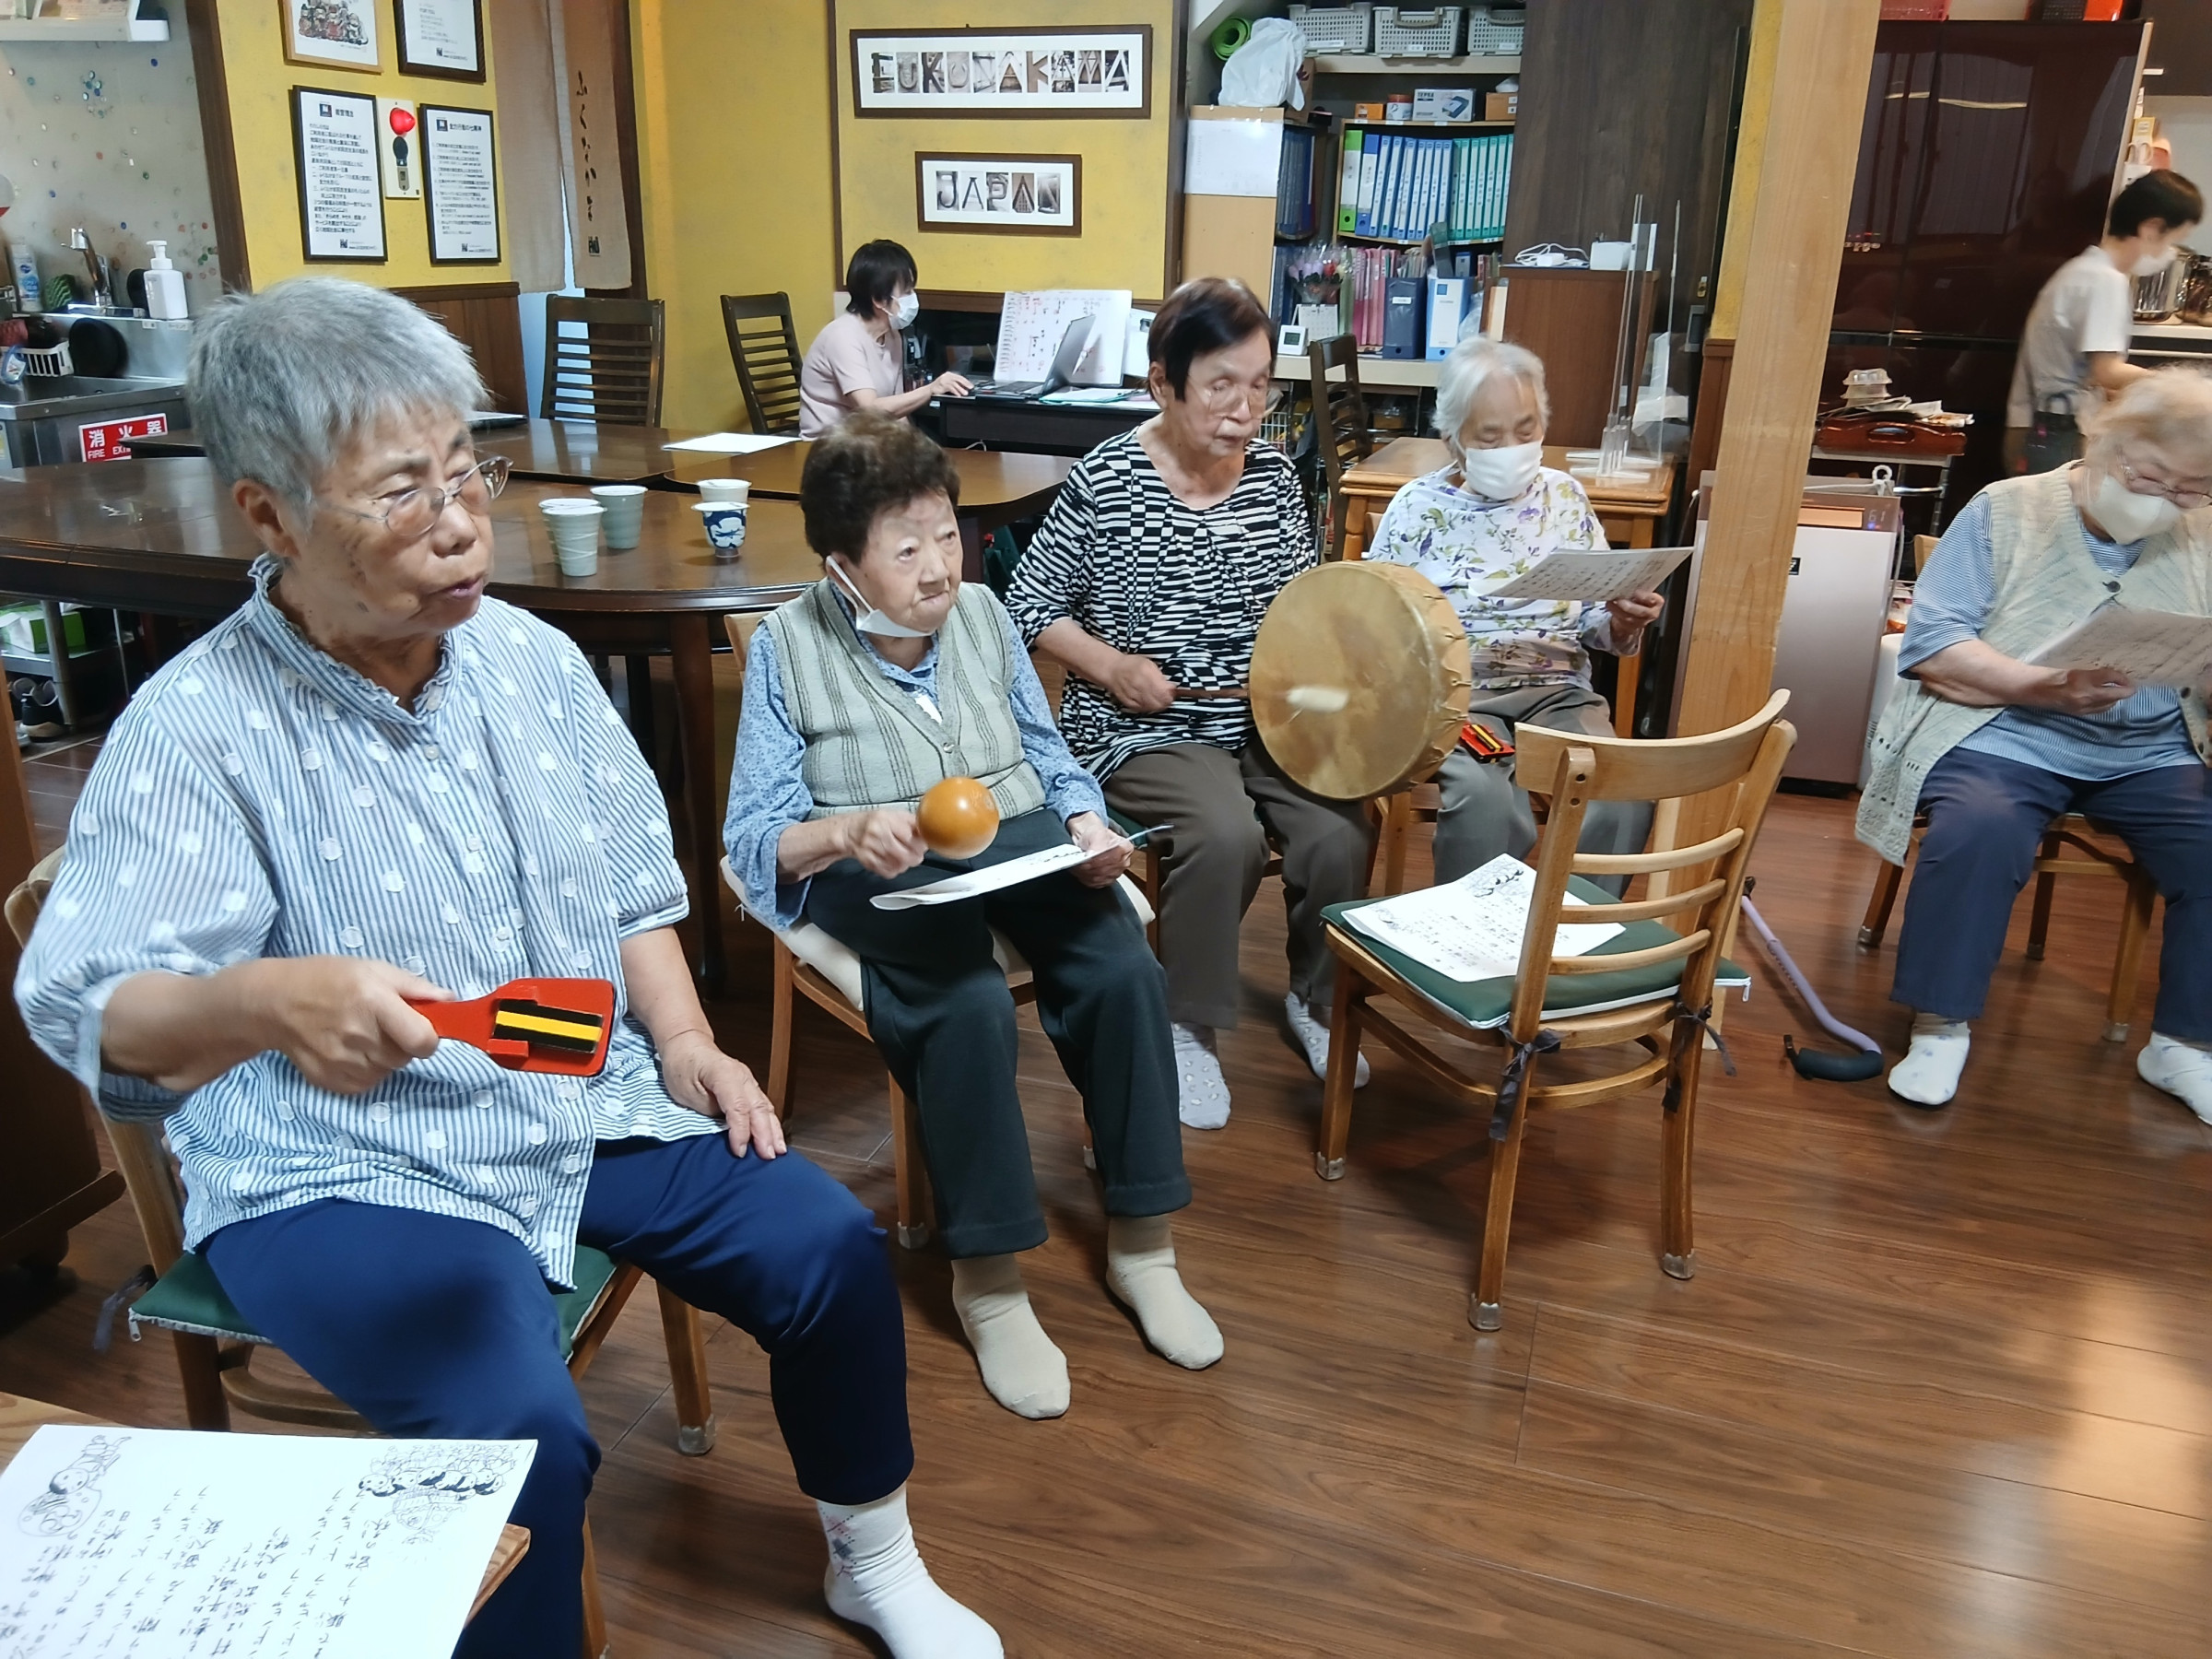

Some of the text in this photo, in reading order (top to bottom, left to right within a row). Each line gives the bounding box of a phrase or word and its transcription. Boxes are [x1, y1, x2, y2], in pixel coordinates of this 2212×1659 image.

[936, 171, 1061, 214] JAPAN
[88, 420, 162, 448] 消火器
[88, 448, 105, 459] FIRE
